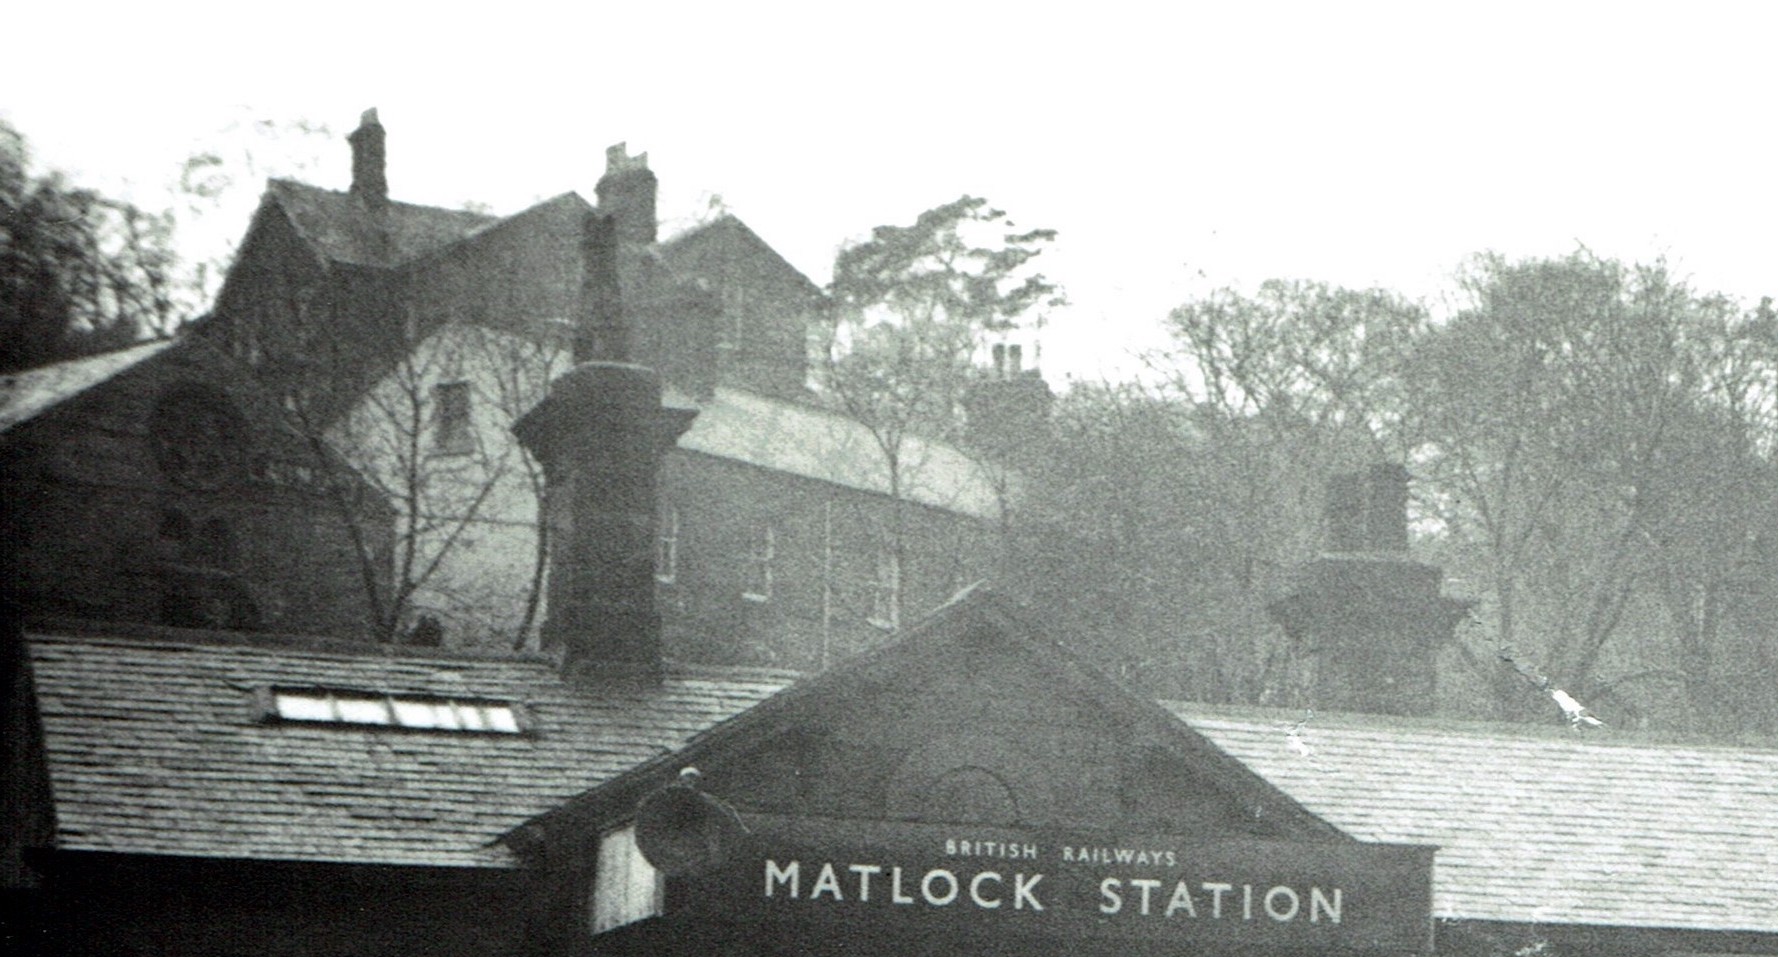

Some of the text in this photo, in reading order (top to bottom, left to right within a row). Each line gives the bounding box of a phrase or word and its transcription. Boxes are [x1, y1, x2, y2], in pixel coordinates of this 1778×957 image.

[945, 839, 1176, 868] BRITISH RAILWAYS
[764, 860, 1343, 924] MATLOCK STATION
